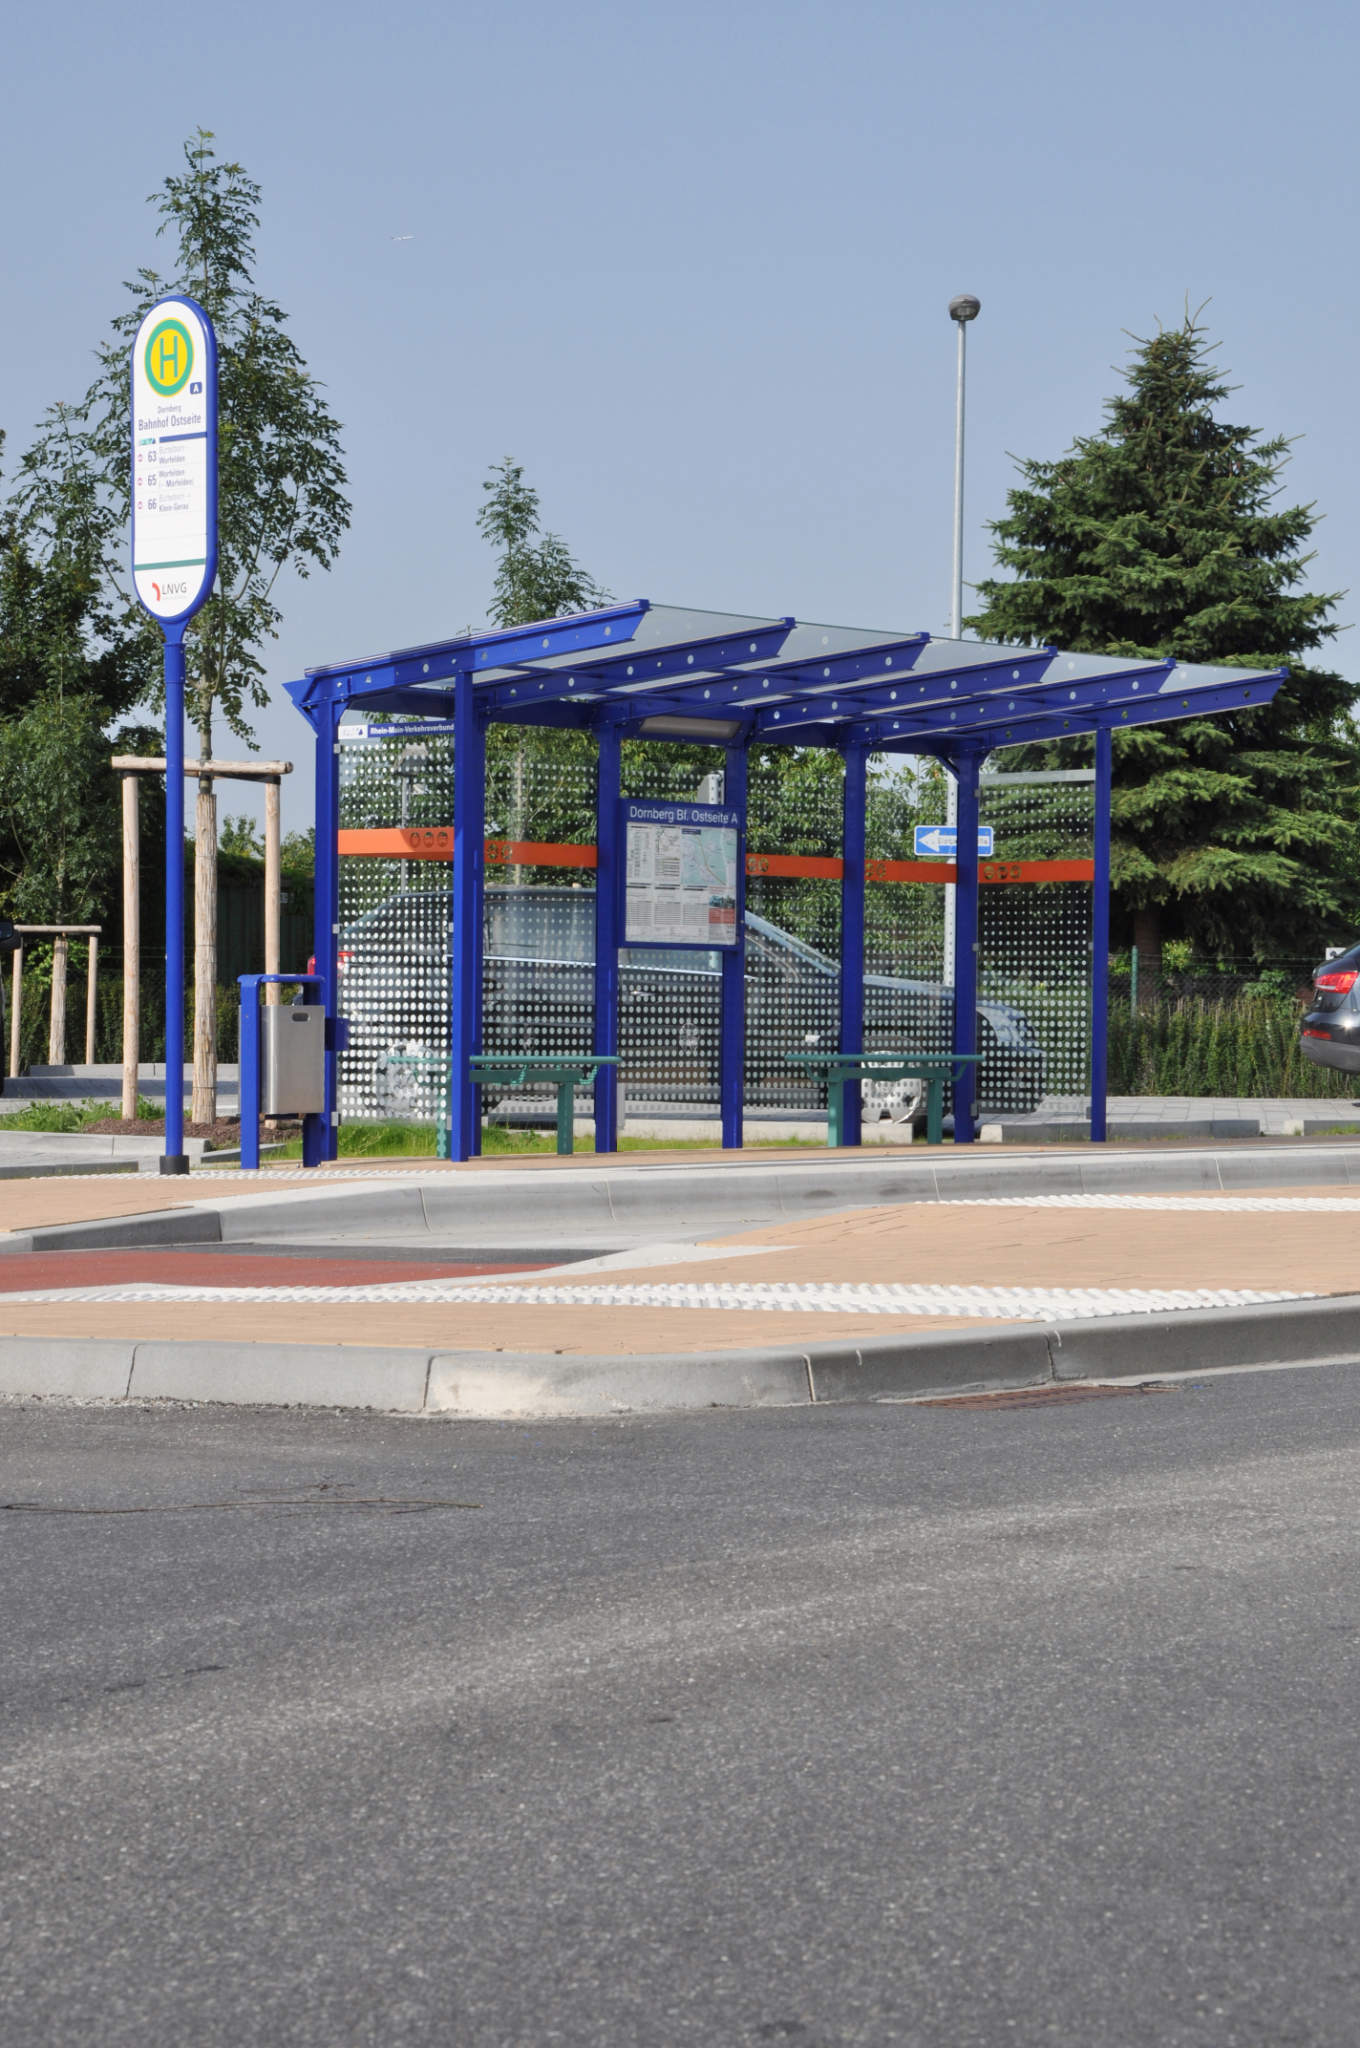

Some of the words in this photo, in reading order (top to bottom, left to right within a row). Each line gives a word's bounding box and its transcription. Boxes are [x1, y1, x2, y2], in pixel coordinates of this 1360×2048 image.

[160, 335, 178, 380] H
[138, 417, 169, 431] Bahnhof
[170, 413, 202, 427] Ostseite
[147, 450, 157, 463] 63
[147, 474, 157, 487] 65
[147, 498, 157, 510] 66
[161, 582, 187, 595] LNVG
[630, 806, 674, 823] Dornberg
[691, 810, 729, 824] Ostseite
[730, 812, 738, 824] A
